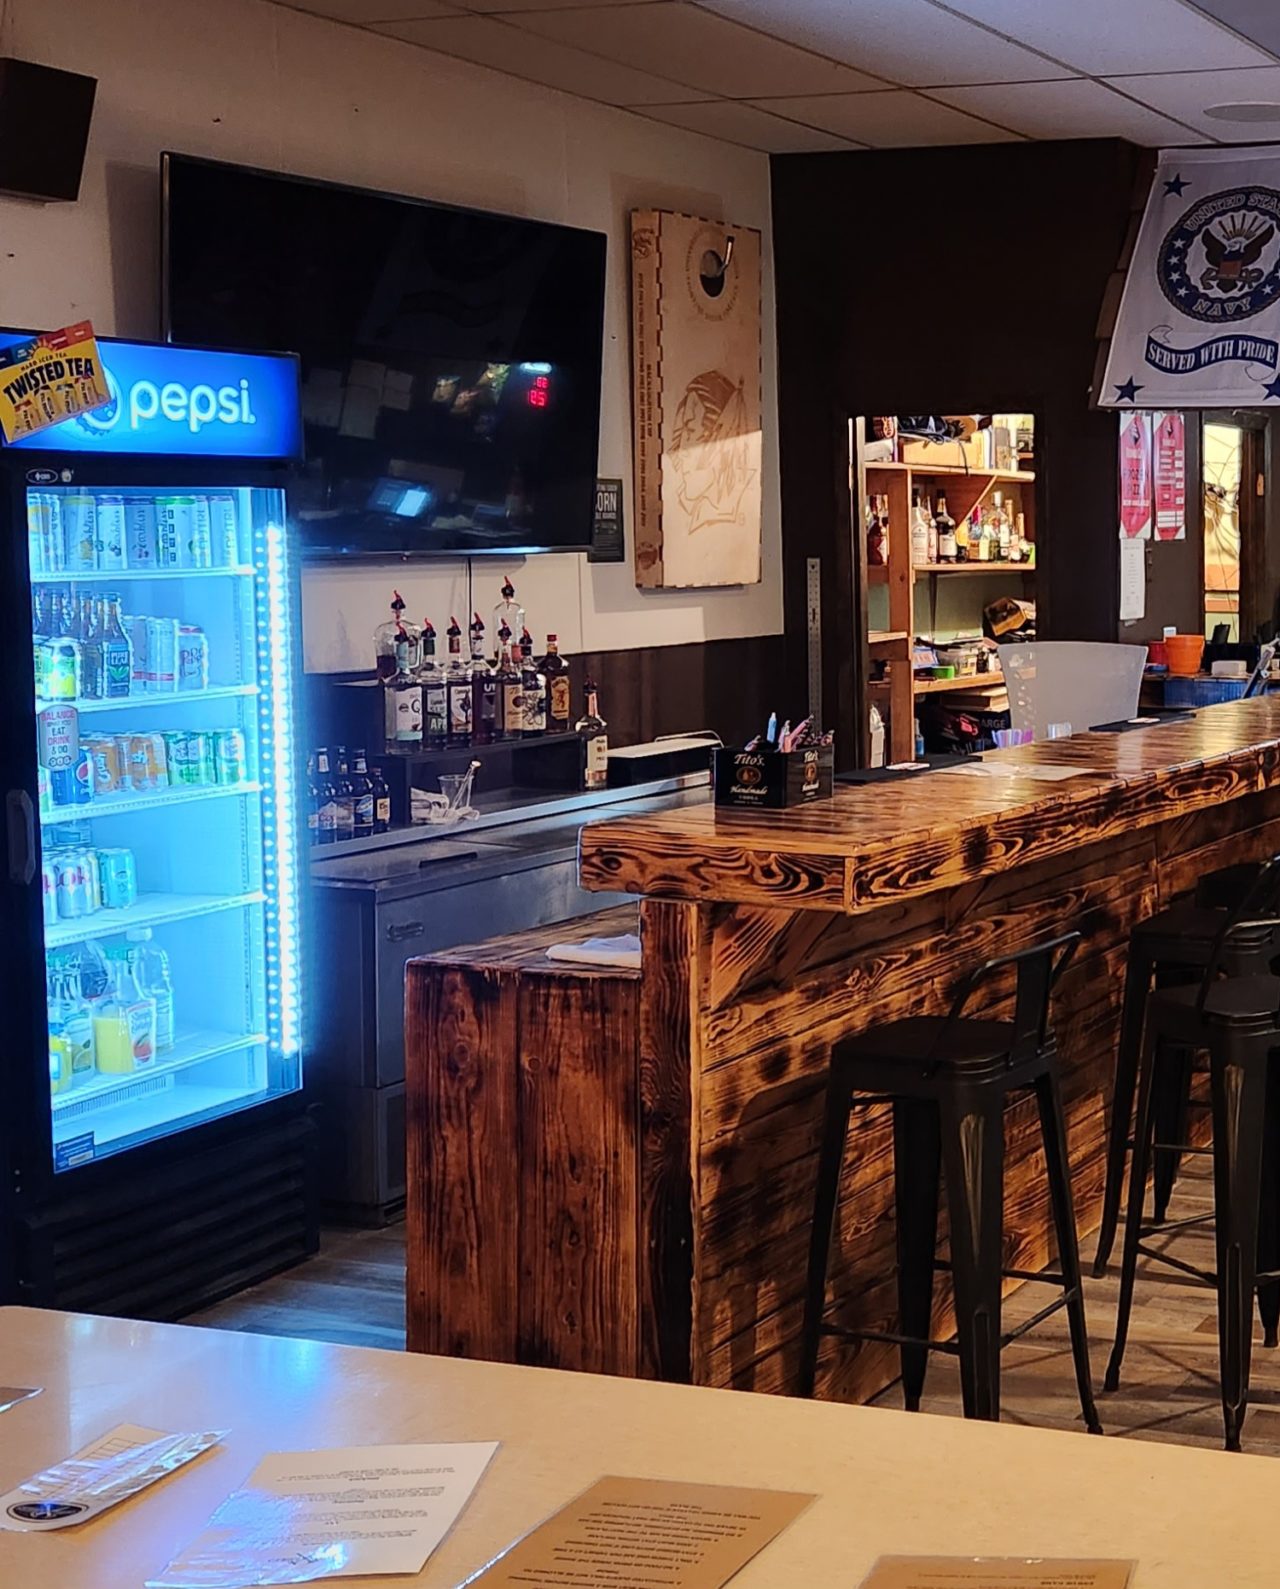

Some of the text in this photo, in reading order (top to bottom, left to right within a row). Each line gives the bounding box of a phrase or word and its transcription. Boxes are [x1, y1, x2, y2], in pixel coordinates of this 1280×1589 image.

[1183, 194, 1246, 231] UNITED
[1191, 297, 1252, 316] NAVY
[1147, 338, 1275, 371] SERVED WITH PRIDE
[3, 360, 66, 405] TWISTED
[65, 357, 95, 377] TEA
[130, 378, 251, 433] pepsi
[596, 491, 617, 513] ORN
[51, 726, 65, 737] EAT
[734, 753, 765, 766] Tito's
